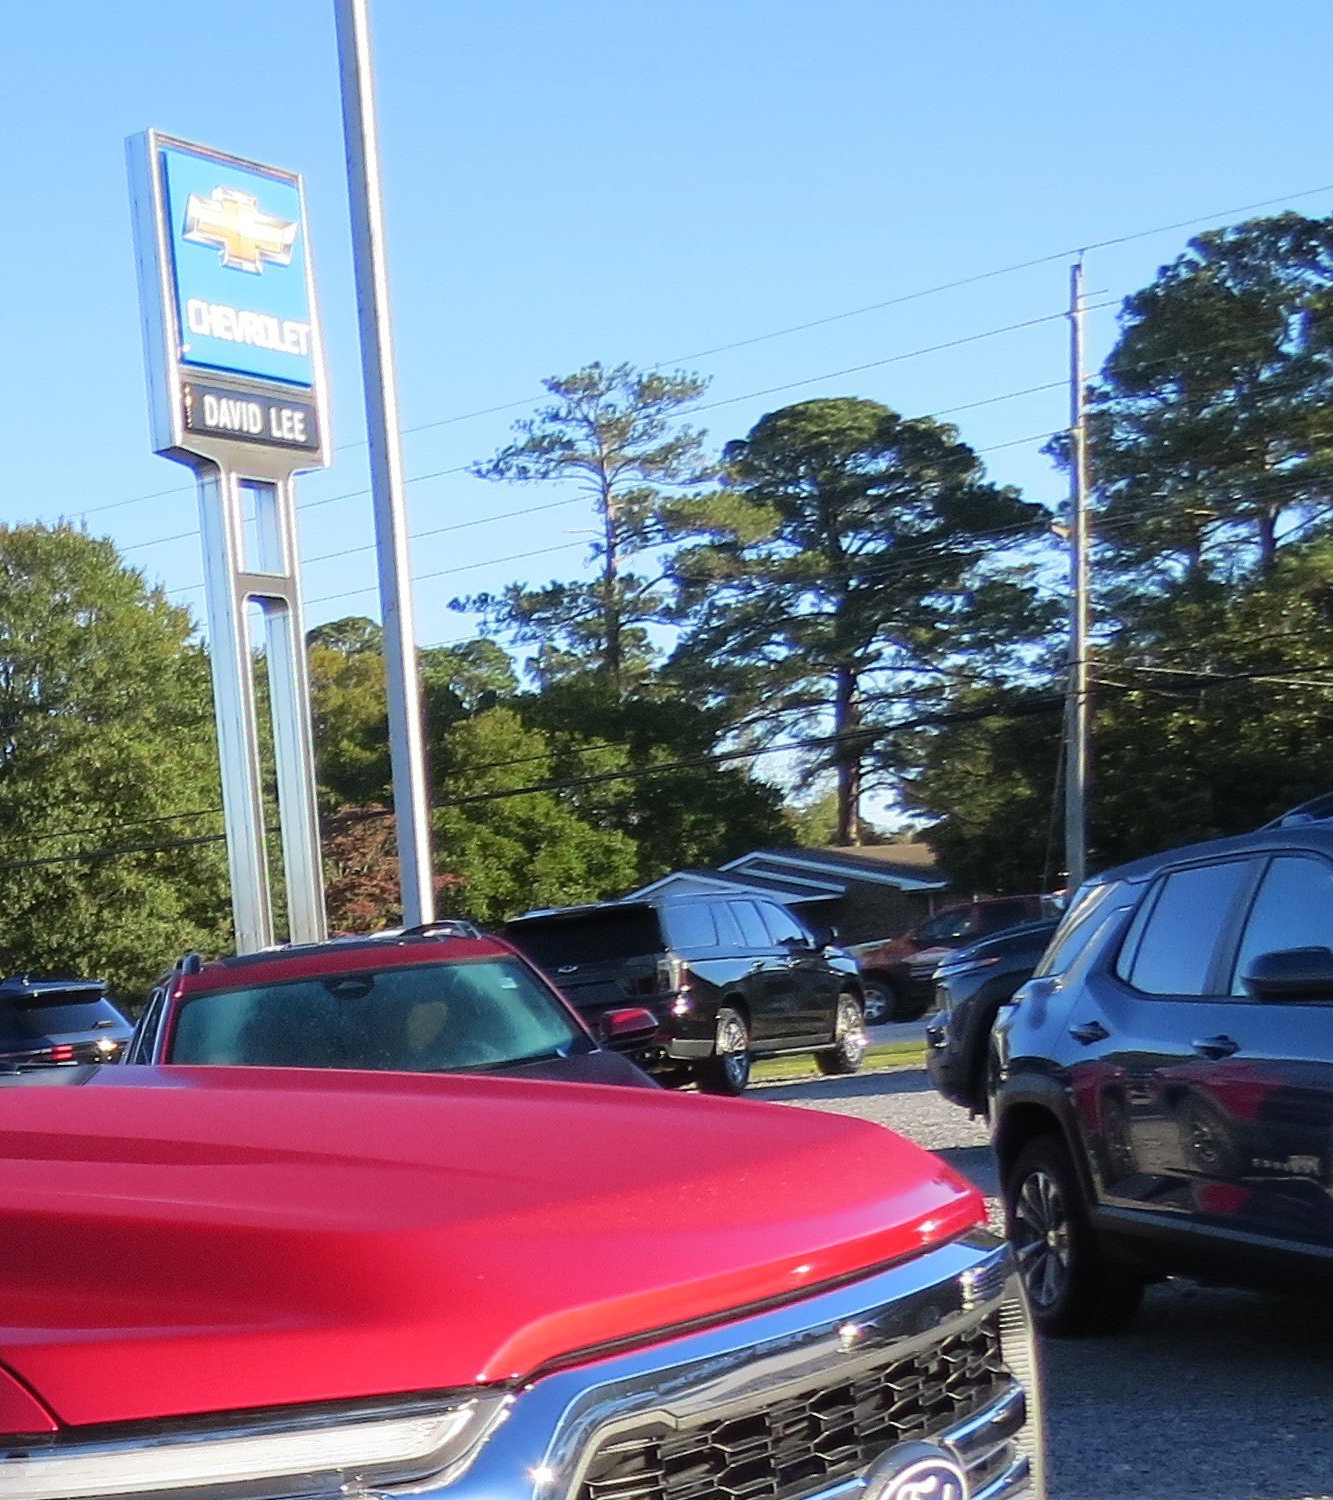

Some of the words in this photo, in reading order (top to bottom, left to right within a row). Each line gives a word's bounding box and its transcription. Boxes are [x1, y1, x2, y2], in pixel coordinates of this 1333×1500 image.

[187, 298, 310, 355] CHEVROLET
[202, 394, 263, 435] DAVID
[269, 406, 308, 443] LEE
